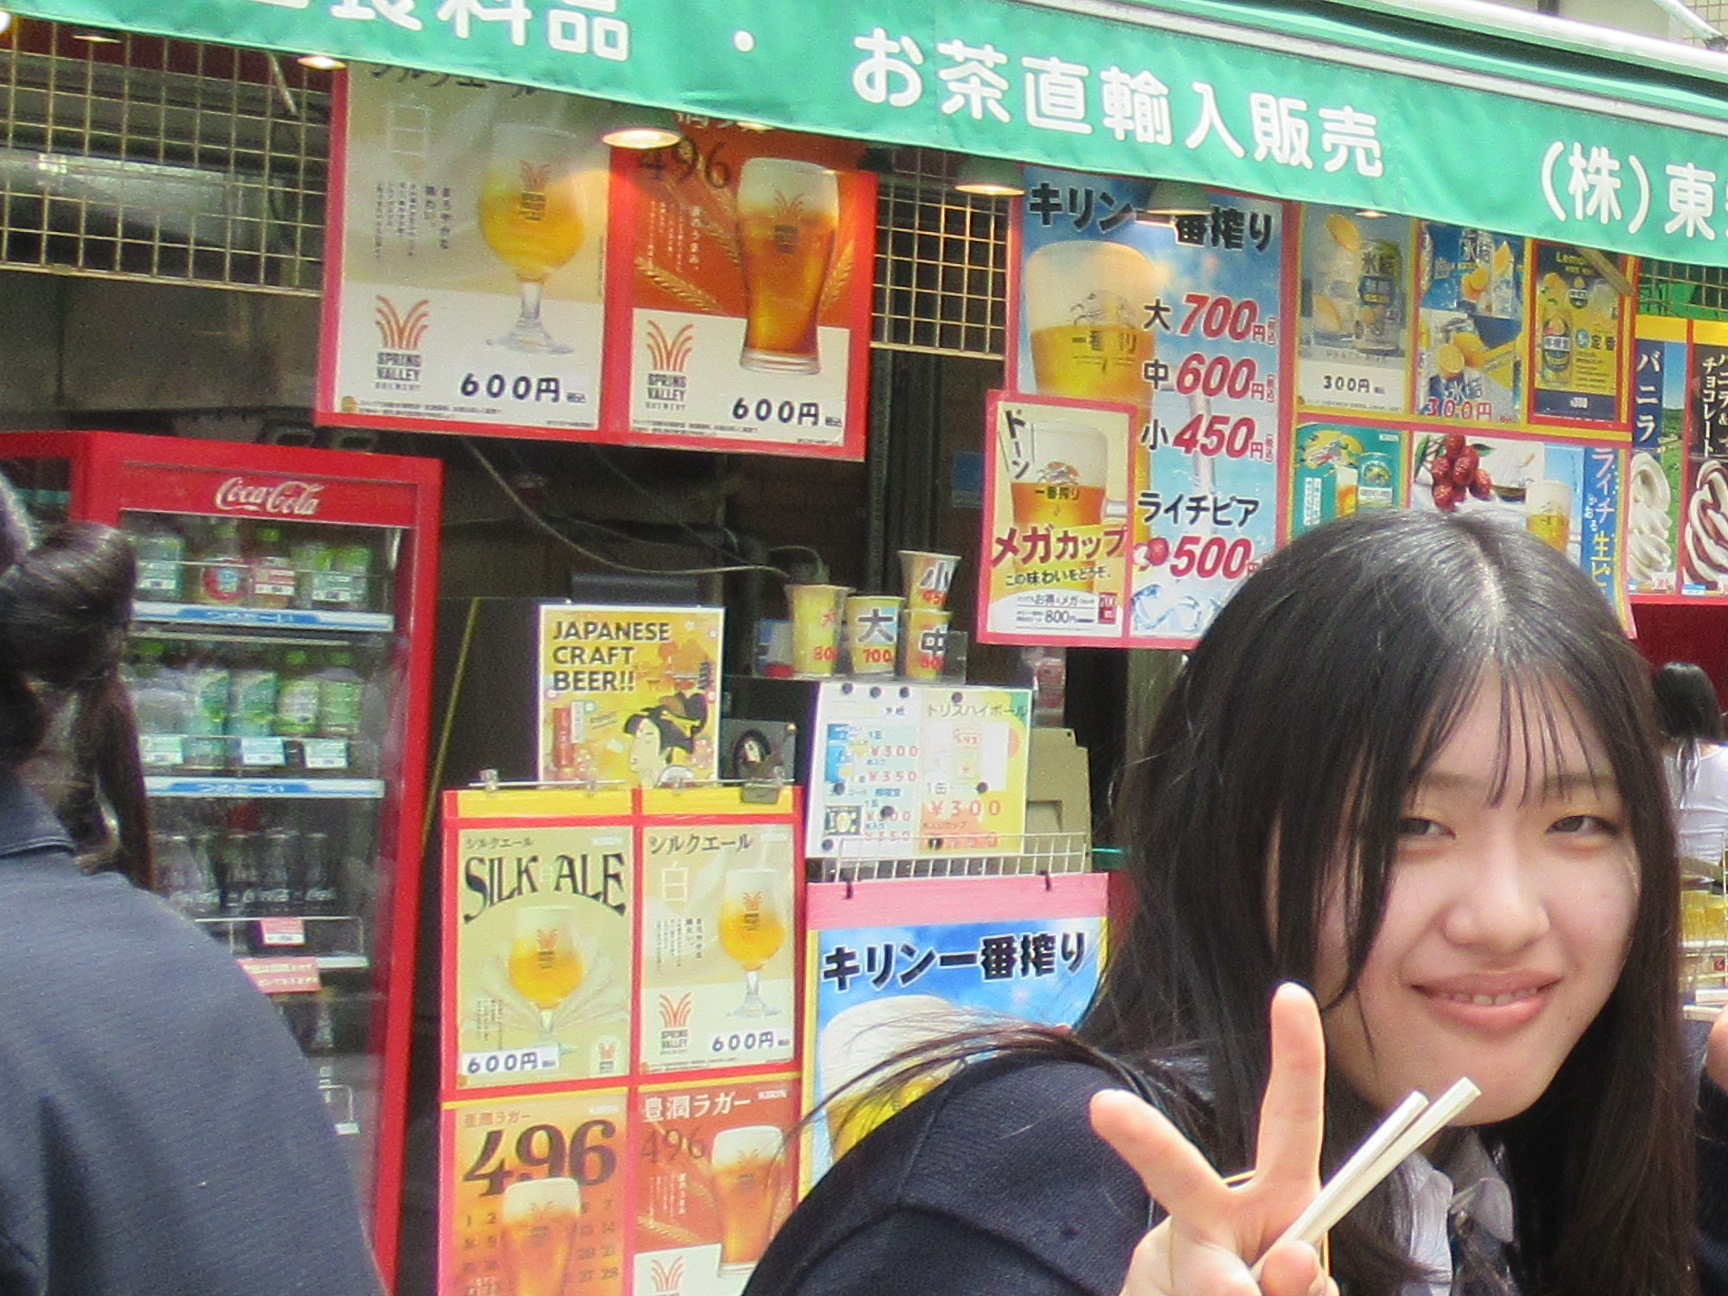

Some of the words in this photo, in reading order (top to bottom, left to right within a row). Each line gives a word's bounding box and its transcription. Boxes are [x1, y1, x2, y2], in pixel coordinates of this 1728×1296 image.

[852, 26, 1383, 179] お茶直輸入販売
[1144, 299, 1171, 331] 大
[460, 372, 561, 404] 600円
[1144, 359, 1168, 390] 中
[1323, 375, 1370, 394] 300円
[732, 396, 820, 428] 600円
[1426, 398, 1493, 422] 300円
[1636, 351, 1661, 442] バニラ
[1702, 357, 1717, 457] チョコレート
[1005, 409, 1030, 480] ドーン
[1141, 419, 1168, 450] 小
[215, 476, 321, 516] Coca-Cola
[1138, 491, 1260, 528] ライチビア
[991, 524, 1128, 568] メガカップ
[553, 620, 671, 642] JAPANESE
[857, 608, 894, 644] 大
[553, 646, 635, 665] CRAFT
[862, 647, 893, 663] 700
[553, 670, 636, 692] BEER!!
[927, 703, 1027, 718] トリスハイボール
[931, 800, 1001, 817] ¥300
[649, 832, 753, 855] シルクエール
[463, 855, 539, 925] SILK
[554, 852, 628, 918] ALE
[821, 930, 1088, 993] キリン一番搾り
[711, 1031, 774, 1053] 600円
[467, 1051, 538, 1075] 600円
[643, 1091, 752, 1122] 豊潤ラガー
[463, 1119, 617, 1198] 496
